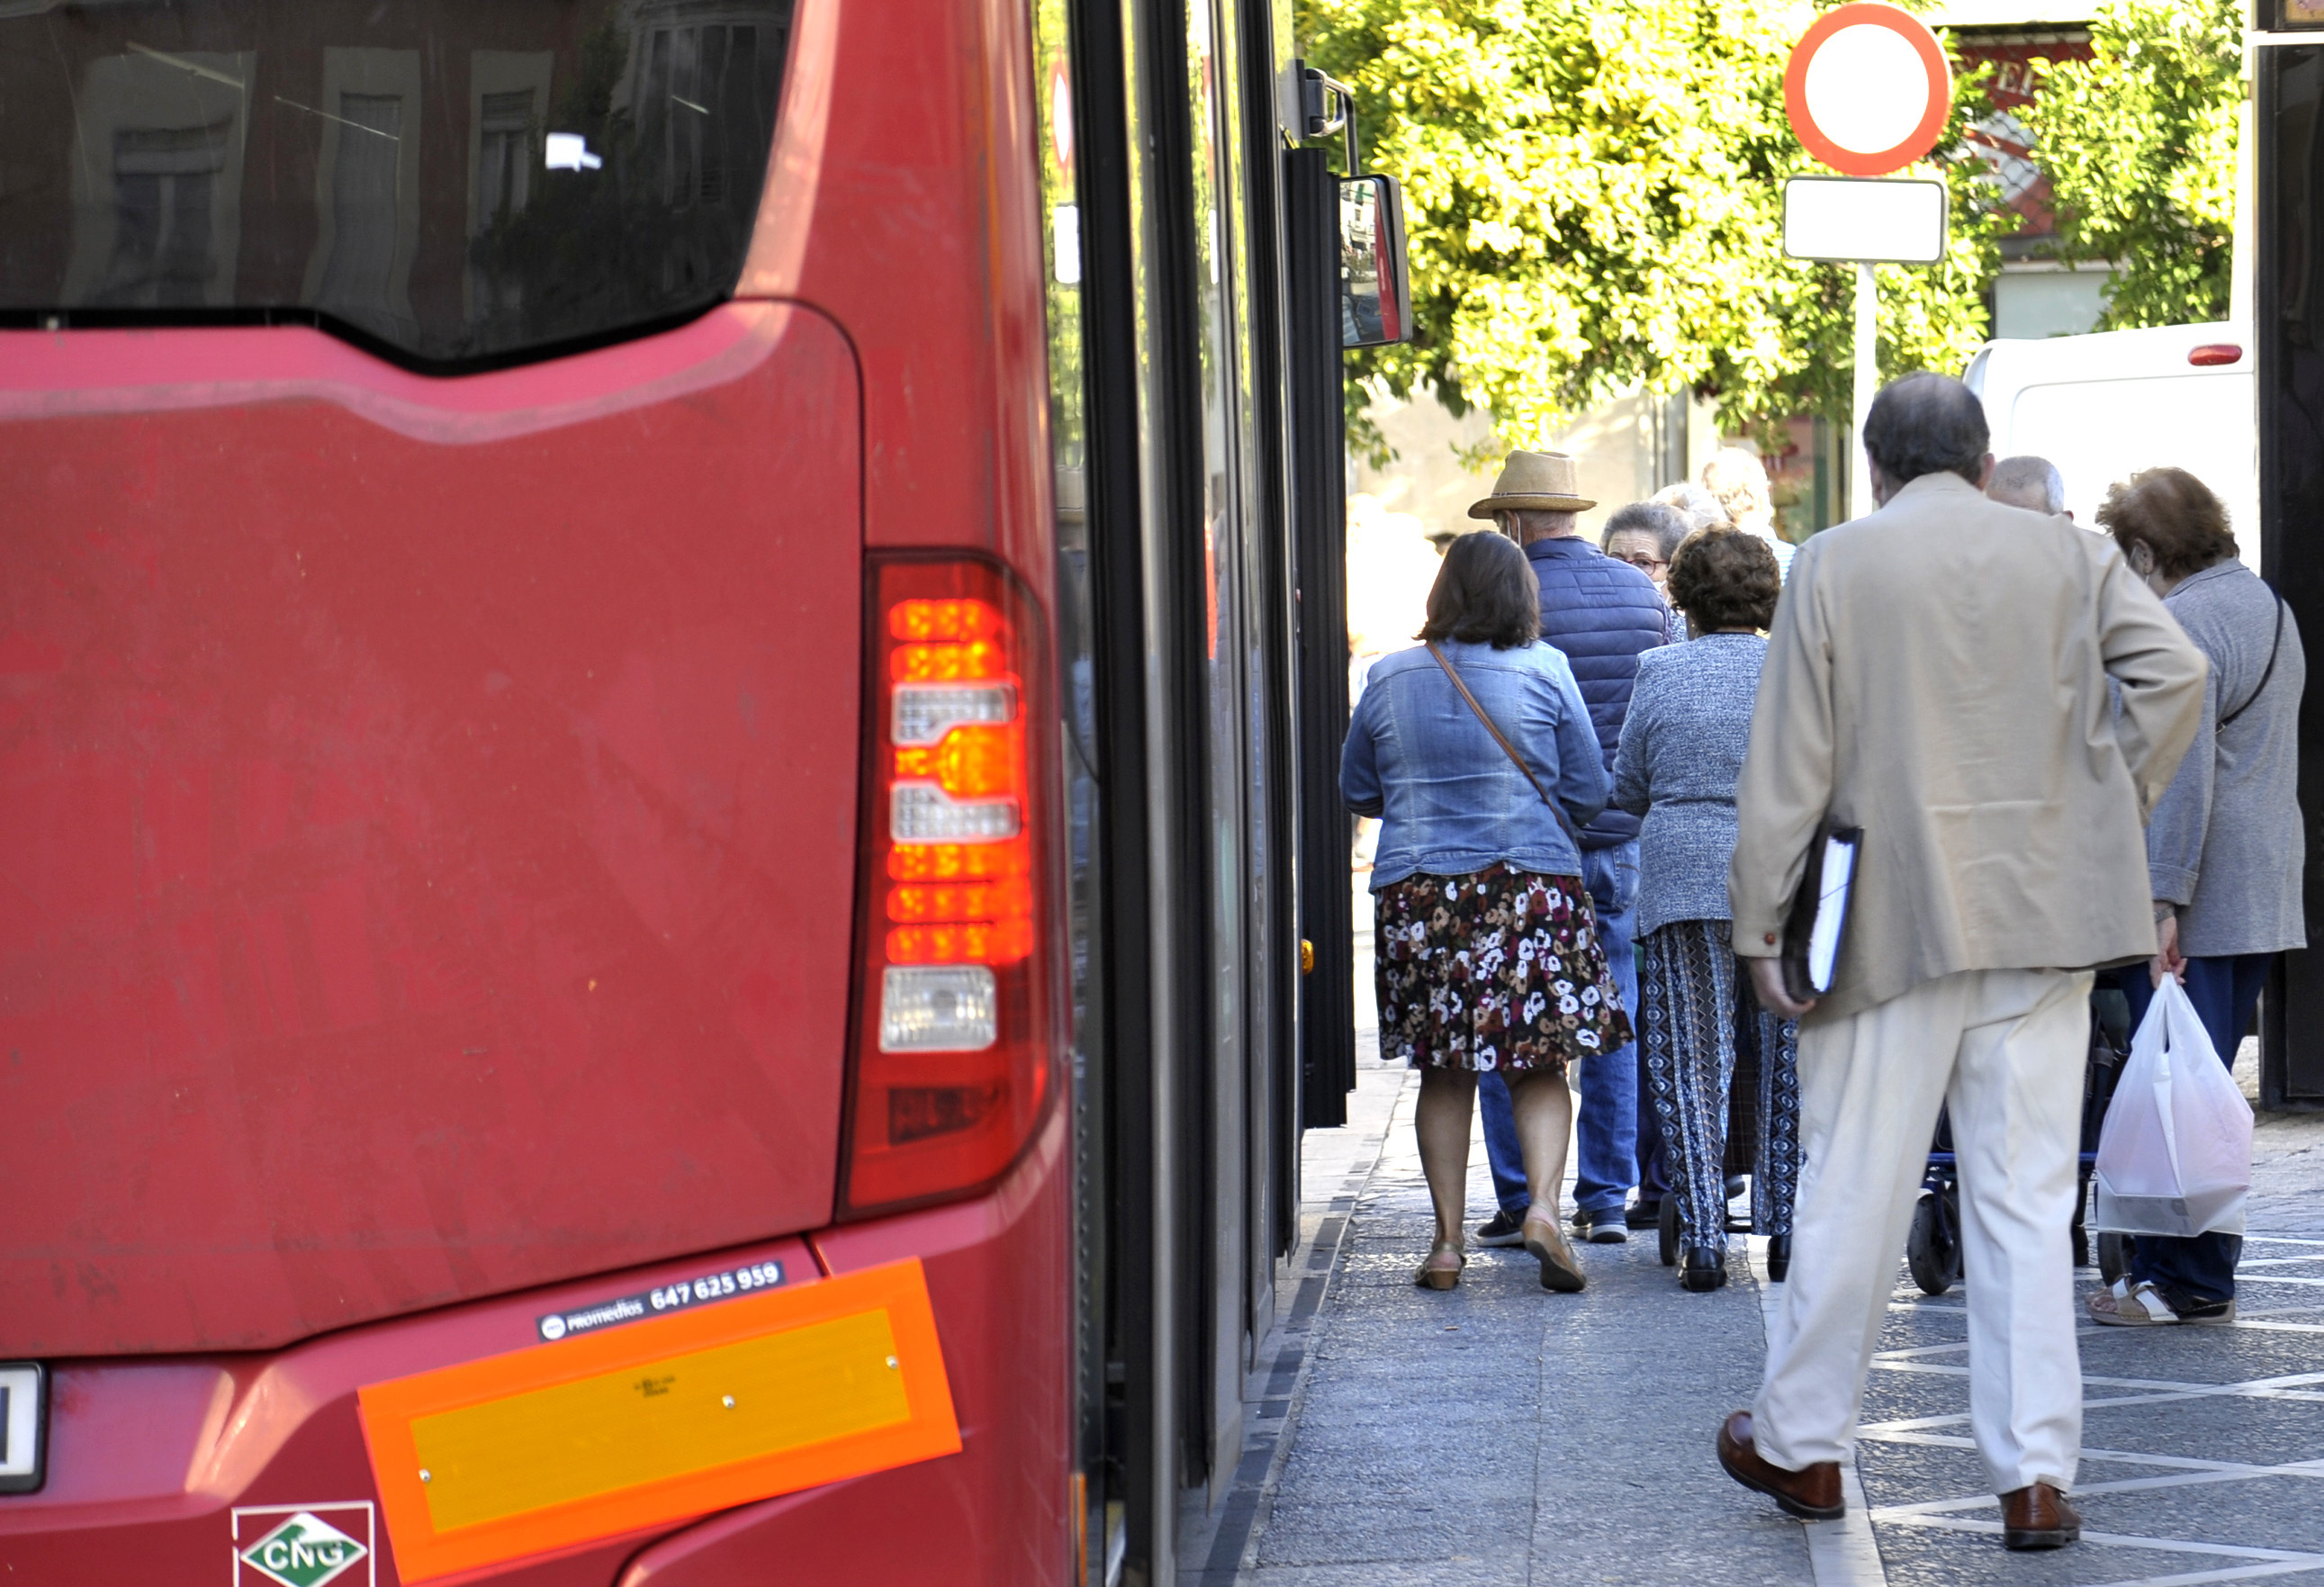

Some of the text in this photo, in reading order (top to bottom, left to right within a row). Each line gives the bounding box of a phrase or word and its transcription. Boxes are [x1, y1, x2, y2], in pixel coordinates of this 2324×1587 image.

[650, 1282, 690, 1310] 647
[694, 1272, 735, 1300] 625
[736, 1262, 779, 1290] 959
[264, 1538, 344, 1571] CNG
